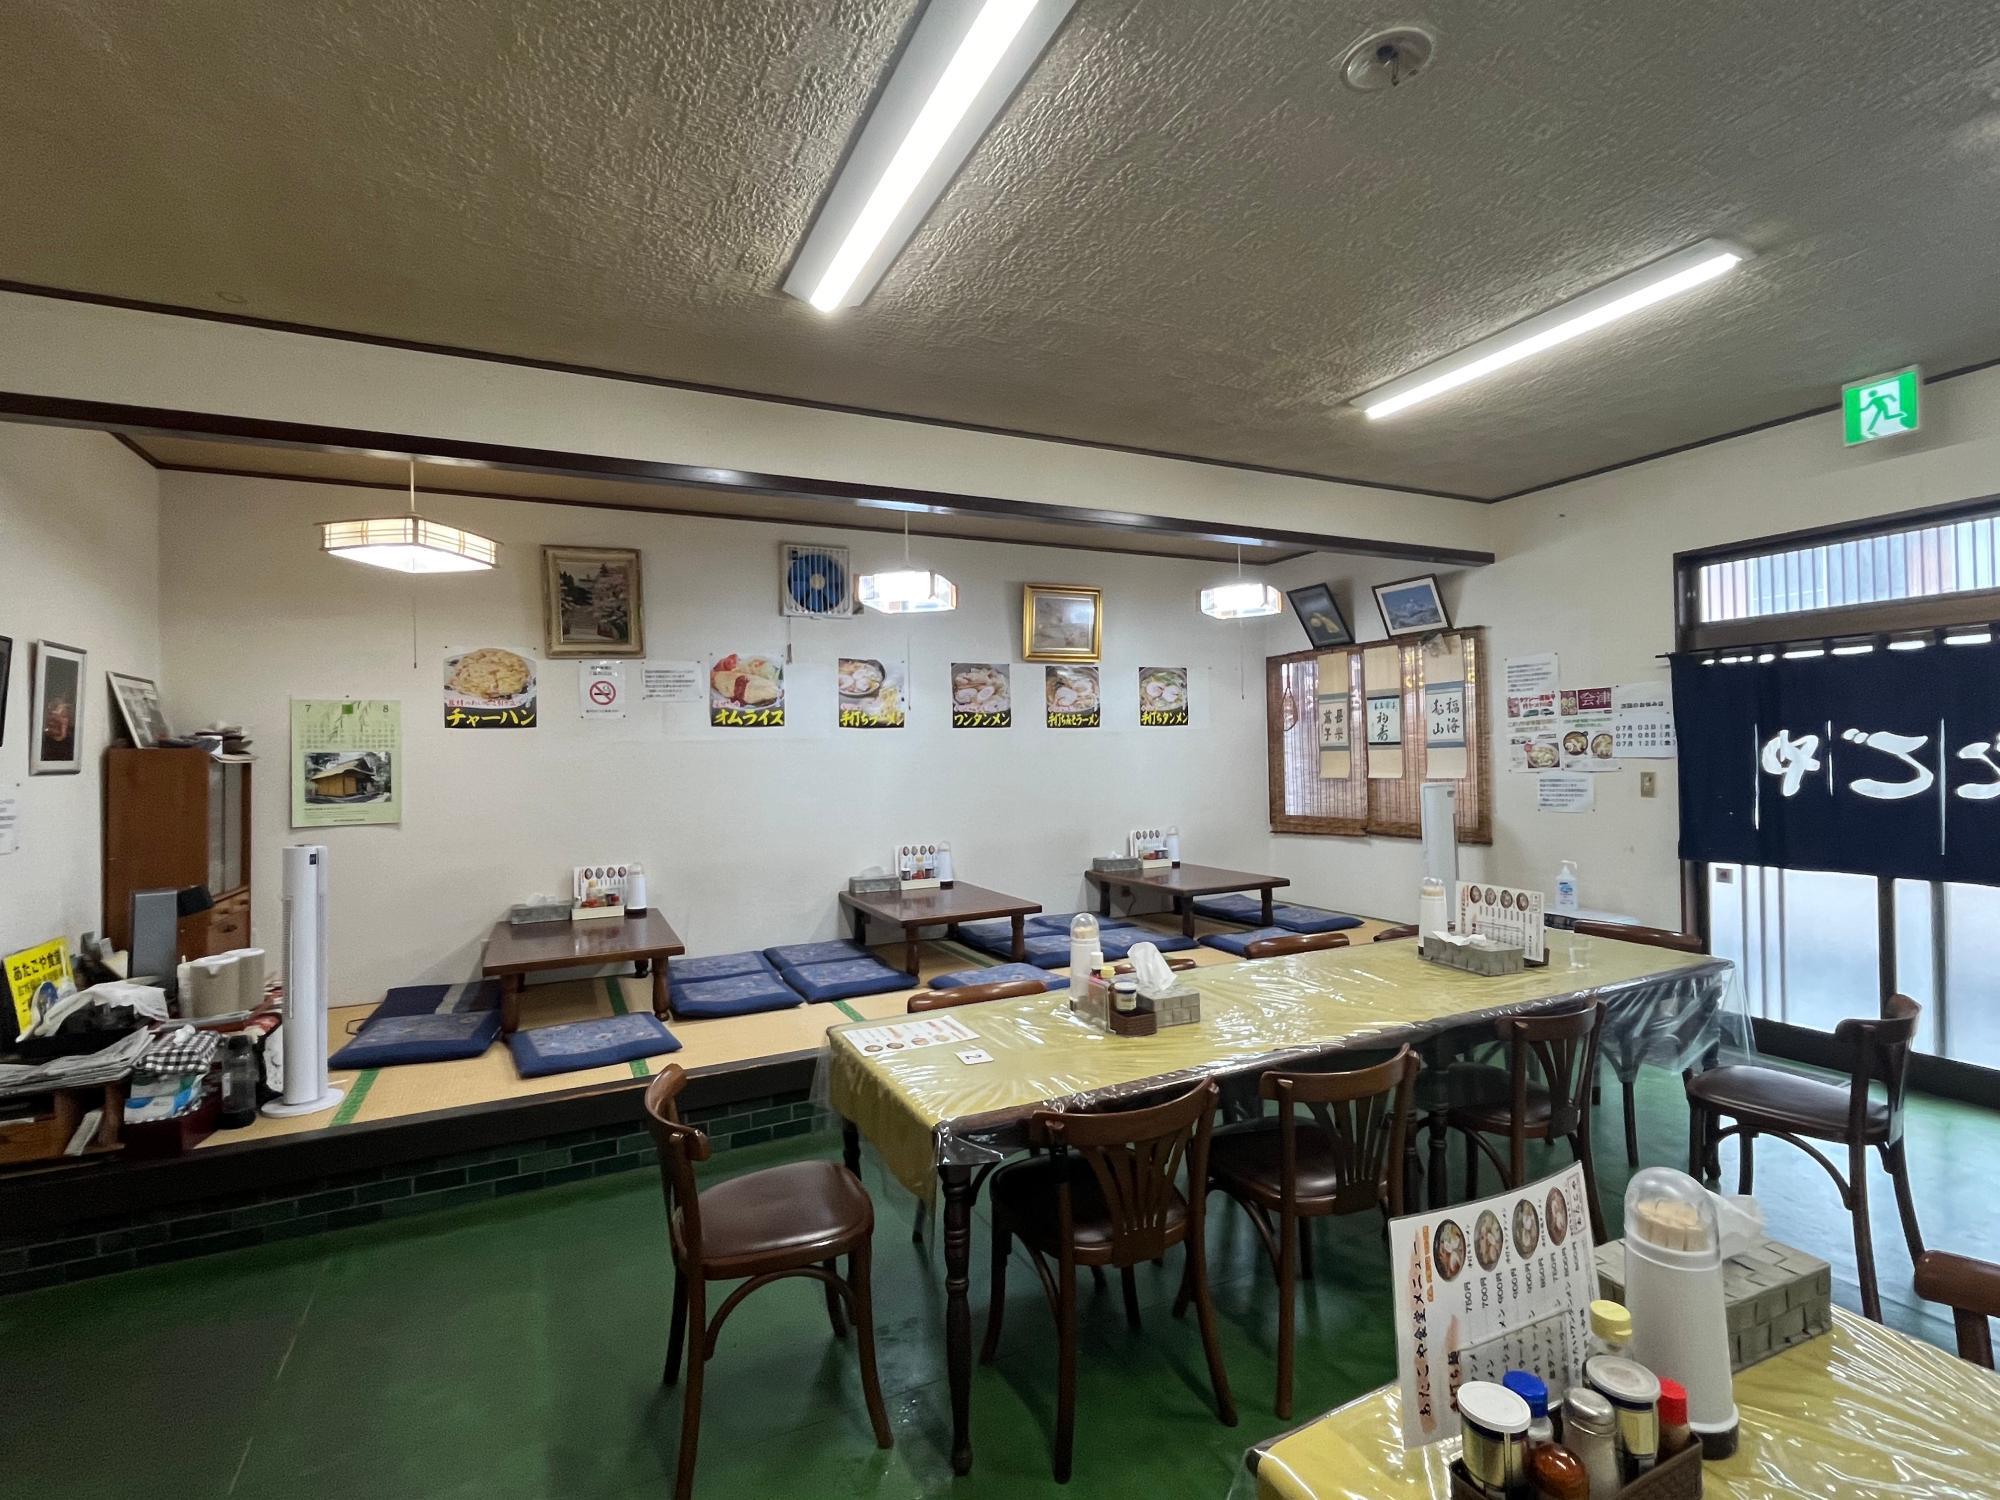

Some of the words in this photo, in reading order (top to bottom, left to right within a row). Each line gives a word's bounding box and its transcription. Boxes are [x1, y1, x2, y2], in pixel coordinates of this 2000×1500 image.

[305, 704, 311, 712] 7
[383, 704, 389, 713] 8
[1580, 691, 1611, 707] 会津
[446, 707, 536, 727] チャーハン
[713, 708, 784, 726] オムライス
[954, 712, 1010, 727] ワンタンメン
[1141, 710, 1188, 725] 手打ちタンメン
[1480, 1276, 1489, 1309] 700円
[1495, 1272, 1504, 1305] 900円
[1510, 1266, 1519, 1300] 900円
[1463, 1281, 1473, 1314] 750円
[1412, 1240, 1433, 1417] あたこや食堂メニュー
